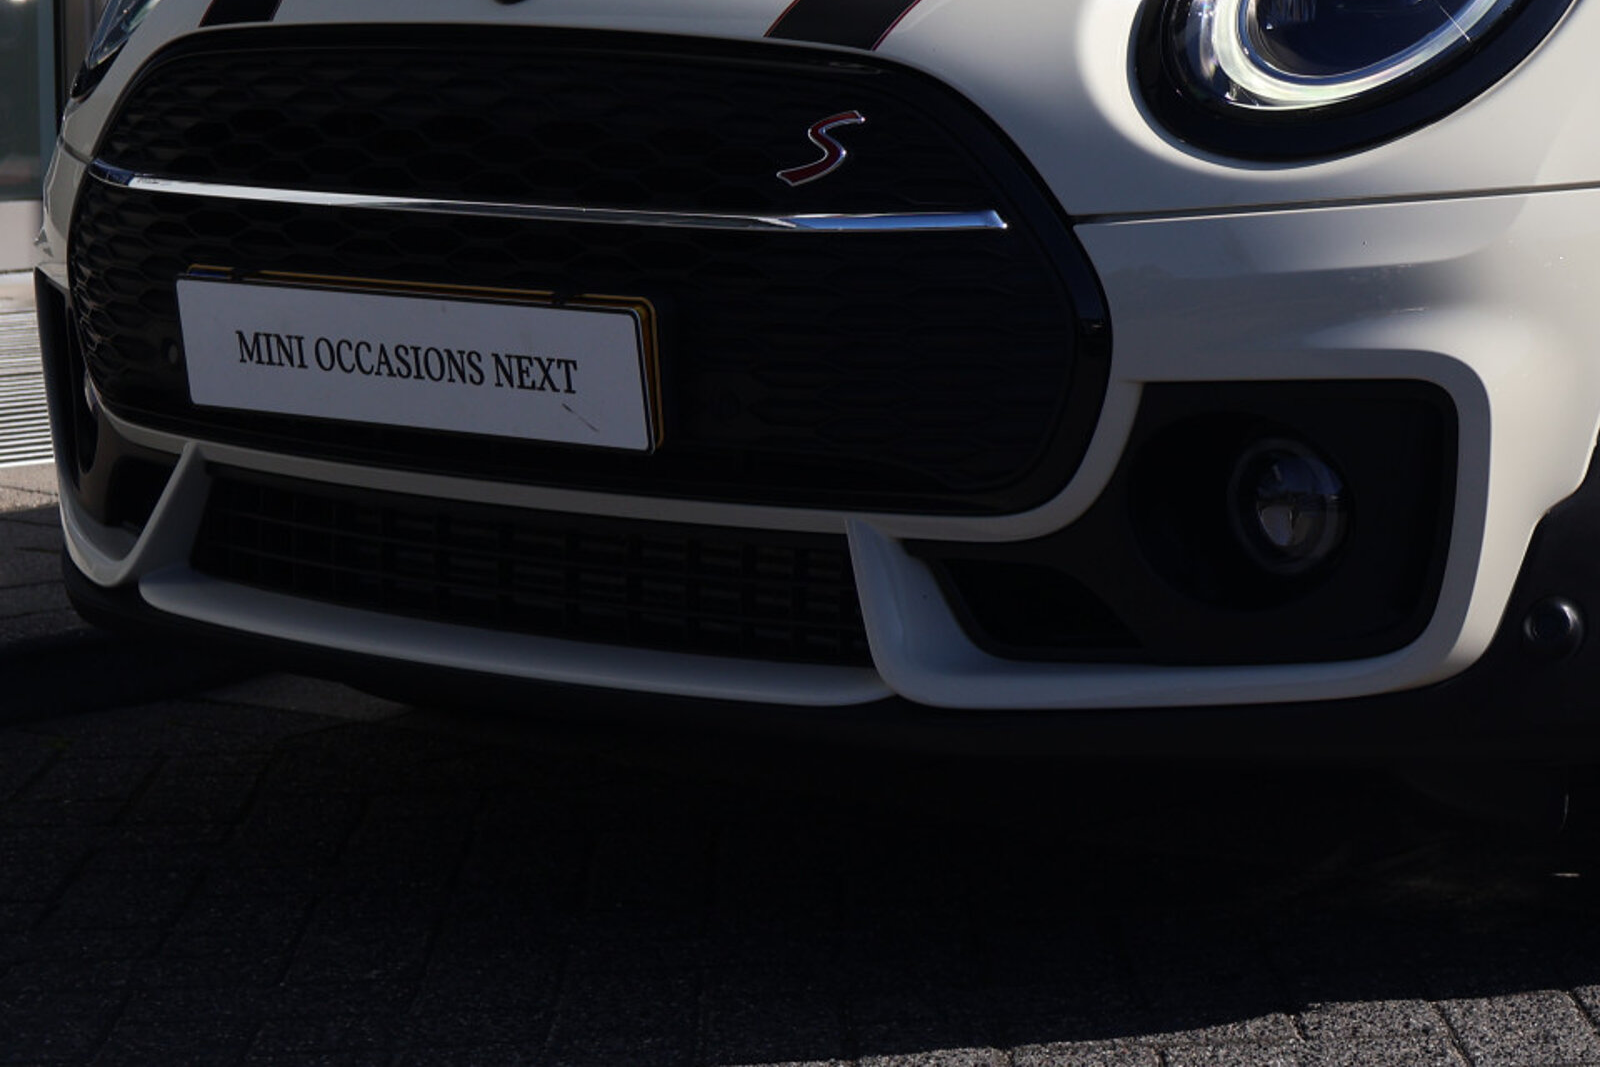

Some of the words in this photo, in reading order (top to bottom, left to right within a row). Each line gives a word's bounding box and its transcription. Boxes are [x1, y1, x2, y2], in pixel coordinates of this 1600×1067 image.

[776, 109, 866, 187] S
[235, 330, 309, 371] MINI
[314, 337, 485, 387] OCCASIONS
[491, 352, 578, 395] NEXT
